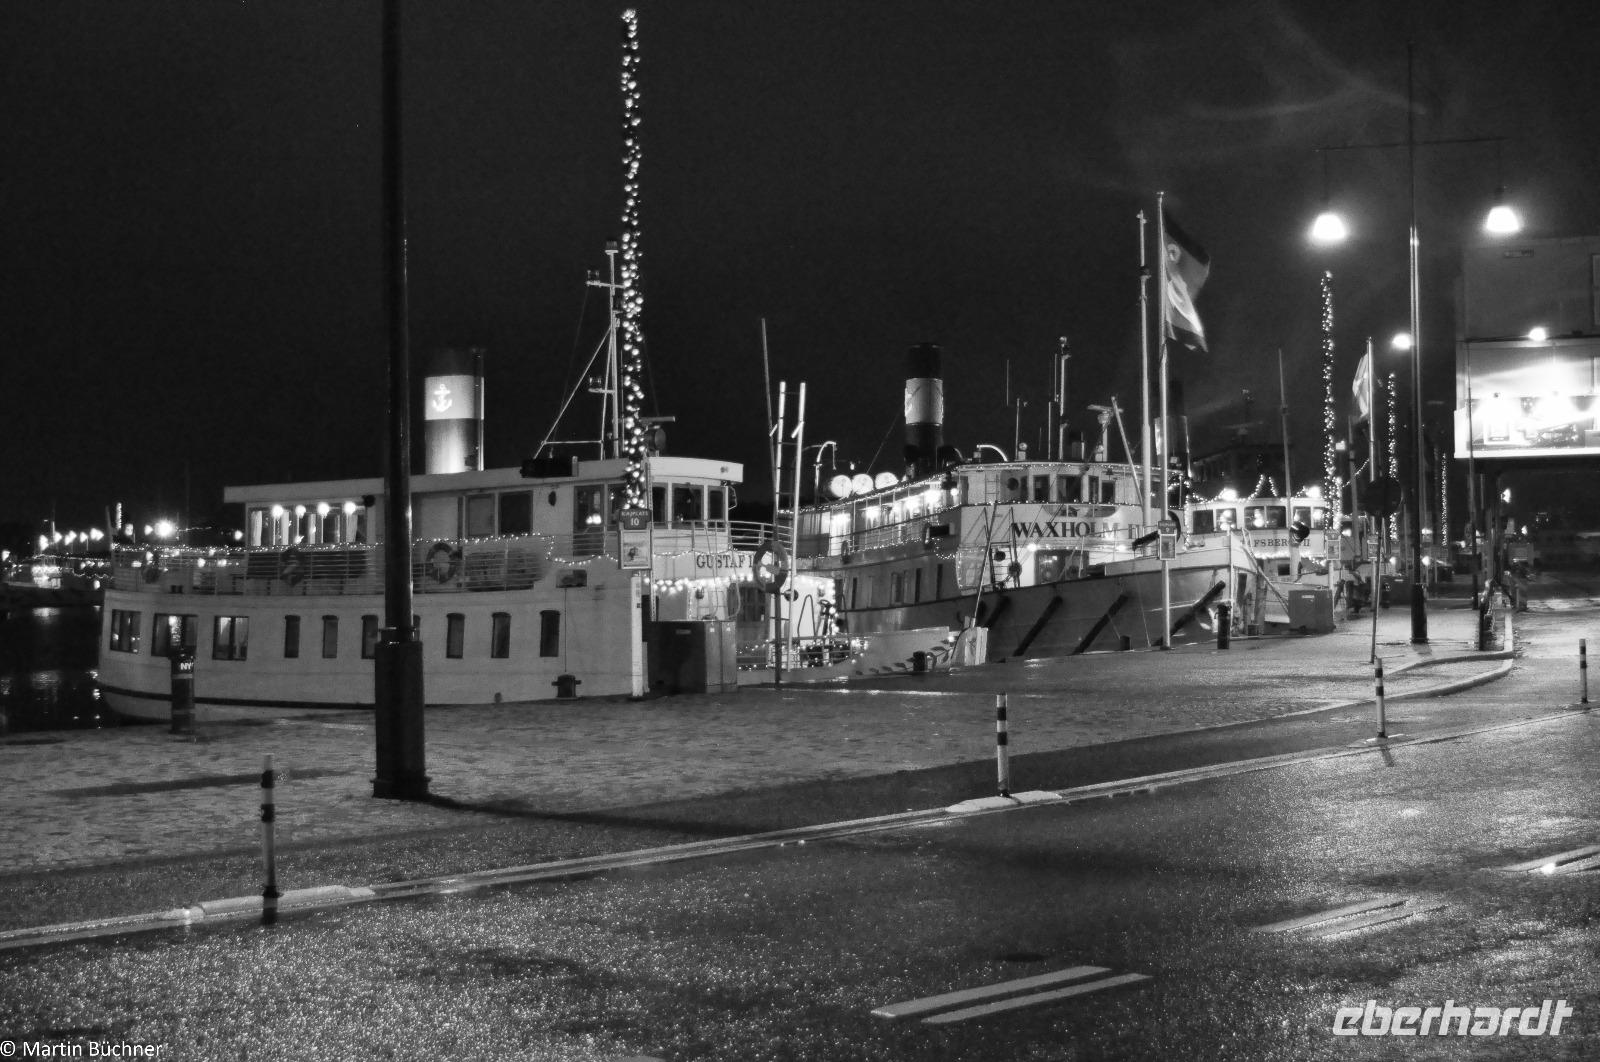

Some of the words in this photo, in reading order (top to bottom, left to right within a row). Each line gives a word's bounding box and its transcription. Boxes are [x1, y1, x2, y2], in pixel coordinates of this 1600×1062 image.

[630, 517, 640, 526] 10
[1011, 521, 1120, 538] WAXHOLM
[696, 554, 745, 569] GUSTAF
